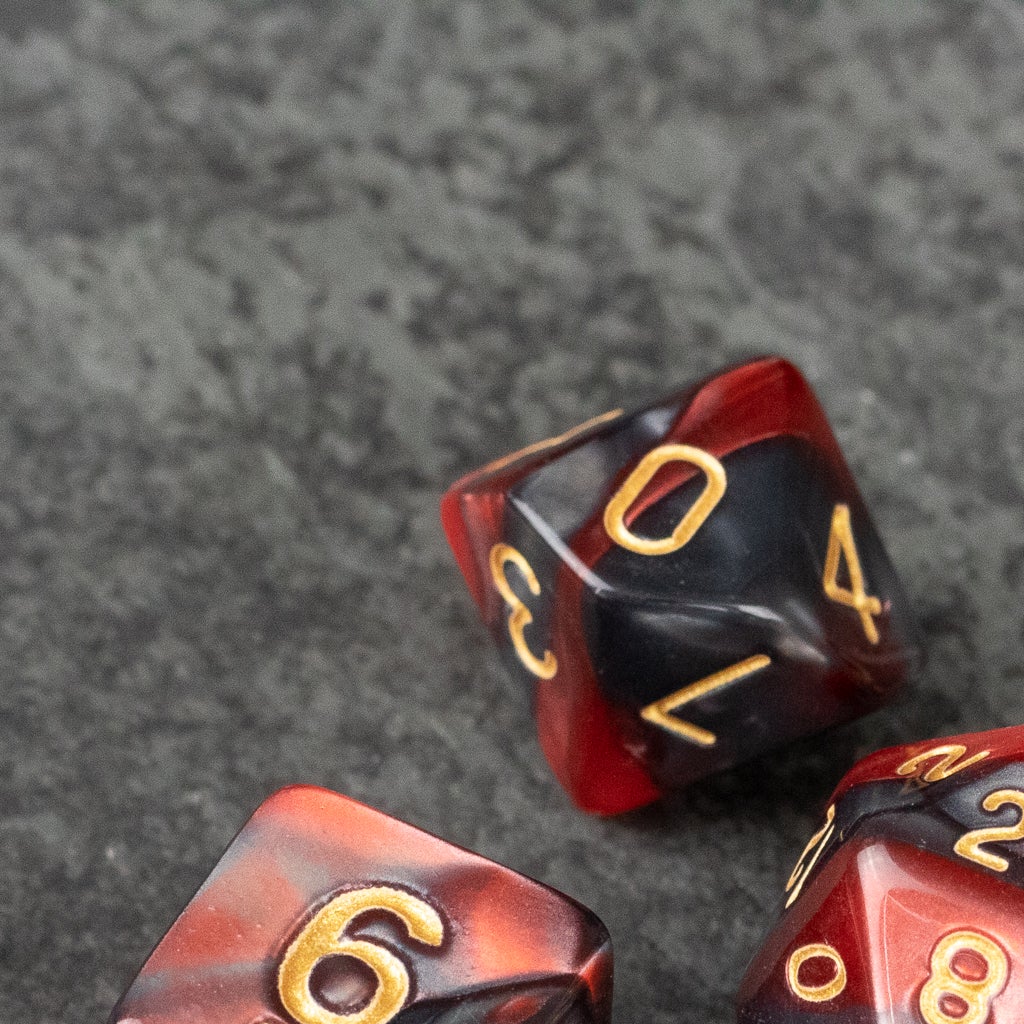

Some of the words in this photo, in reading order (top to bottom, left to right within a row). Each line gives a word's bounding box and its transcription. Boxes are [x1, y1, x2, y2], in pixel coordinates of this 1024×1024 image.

[603, 444, 727, 555] 0
[489, 544, 557, 680] 3
[823, 504, 882, 644] 4
[641, 655, 771, 745] 7
[897, 745, 989, 782] 2
